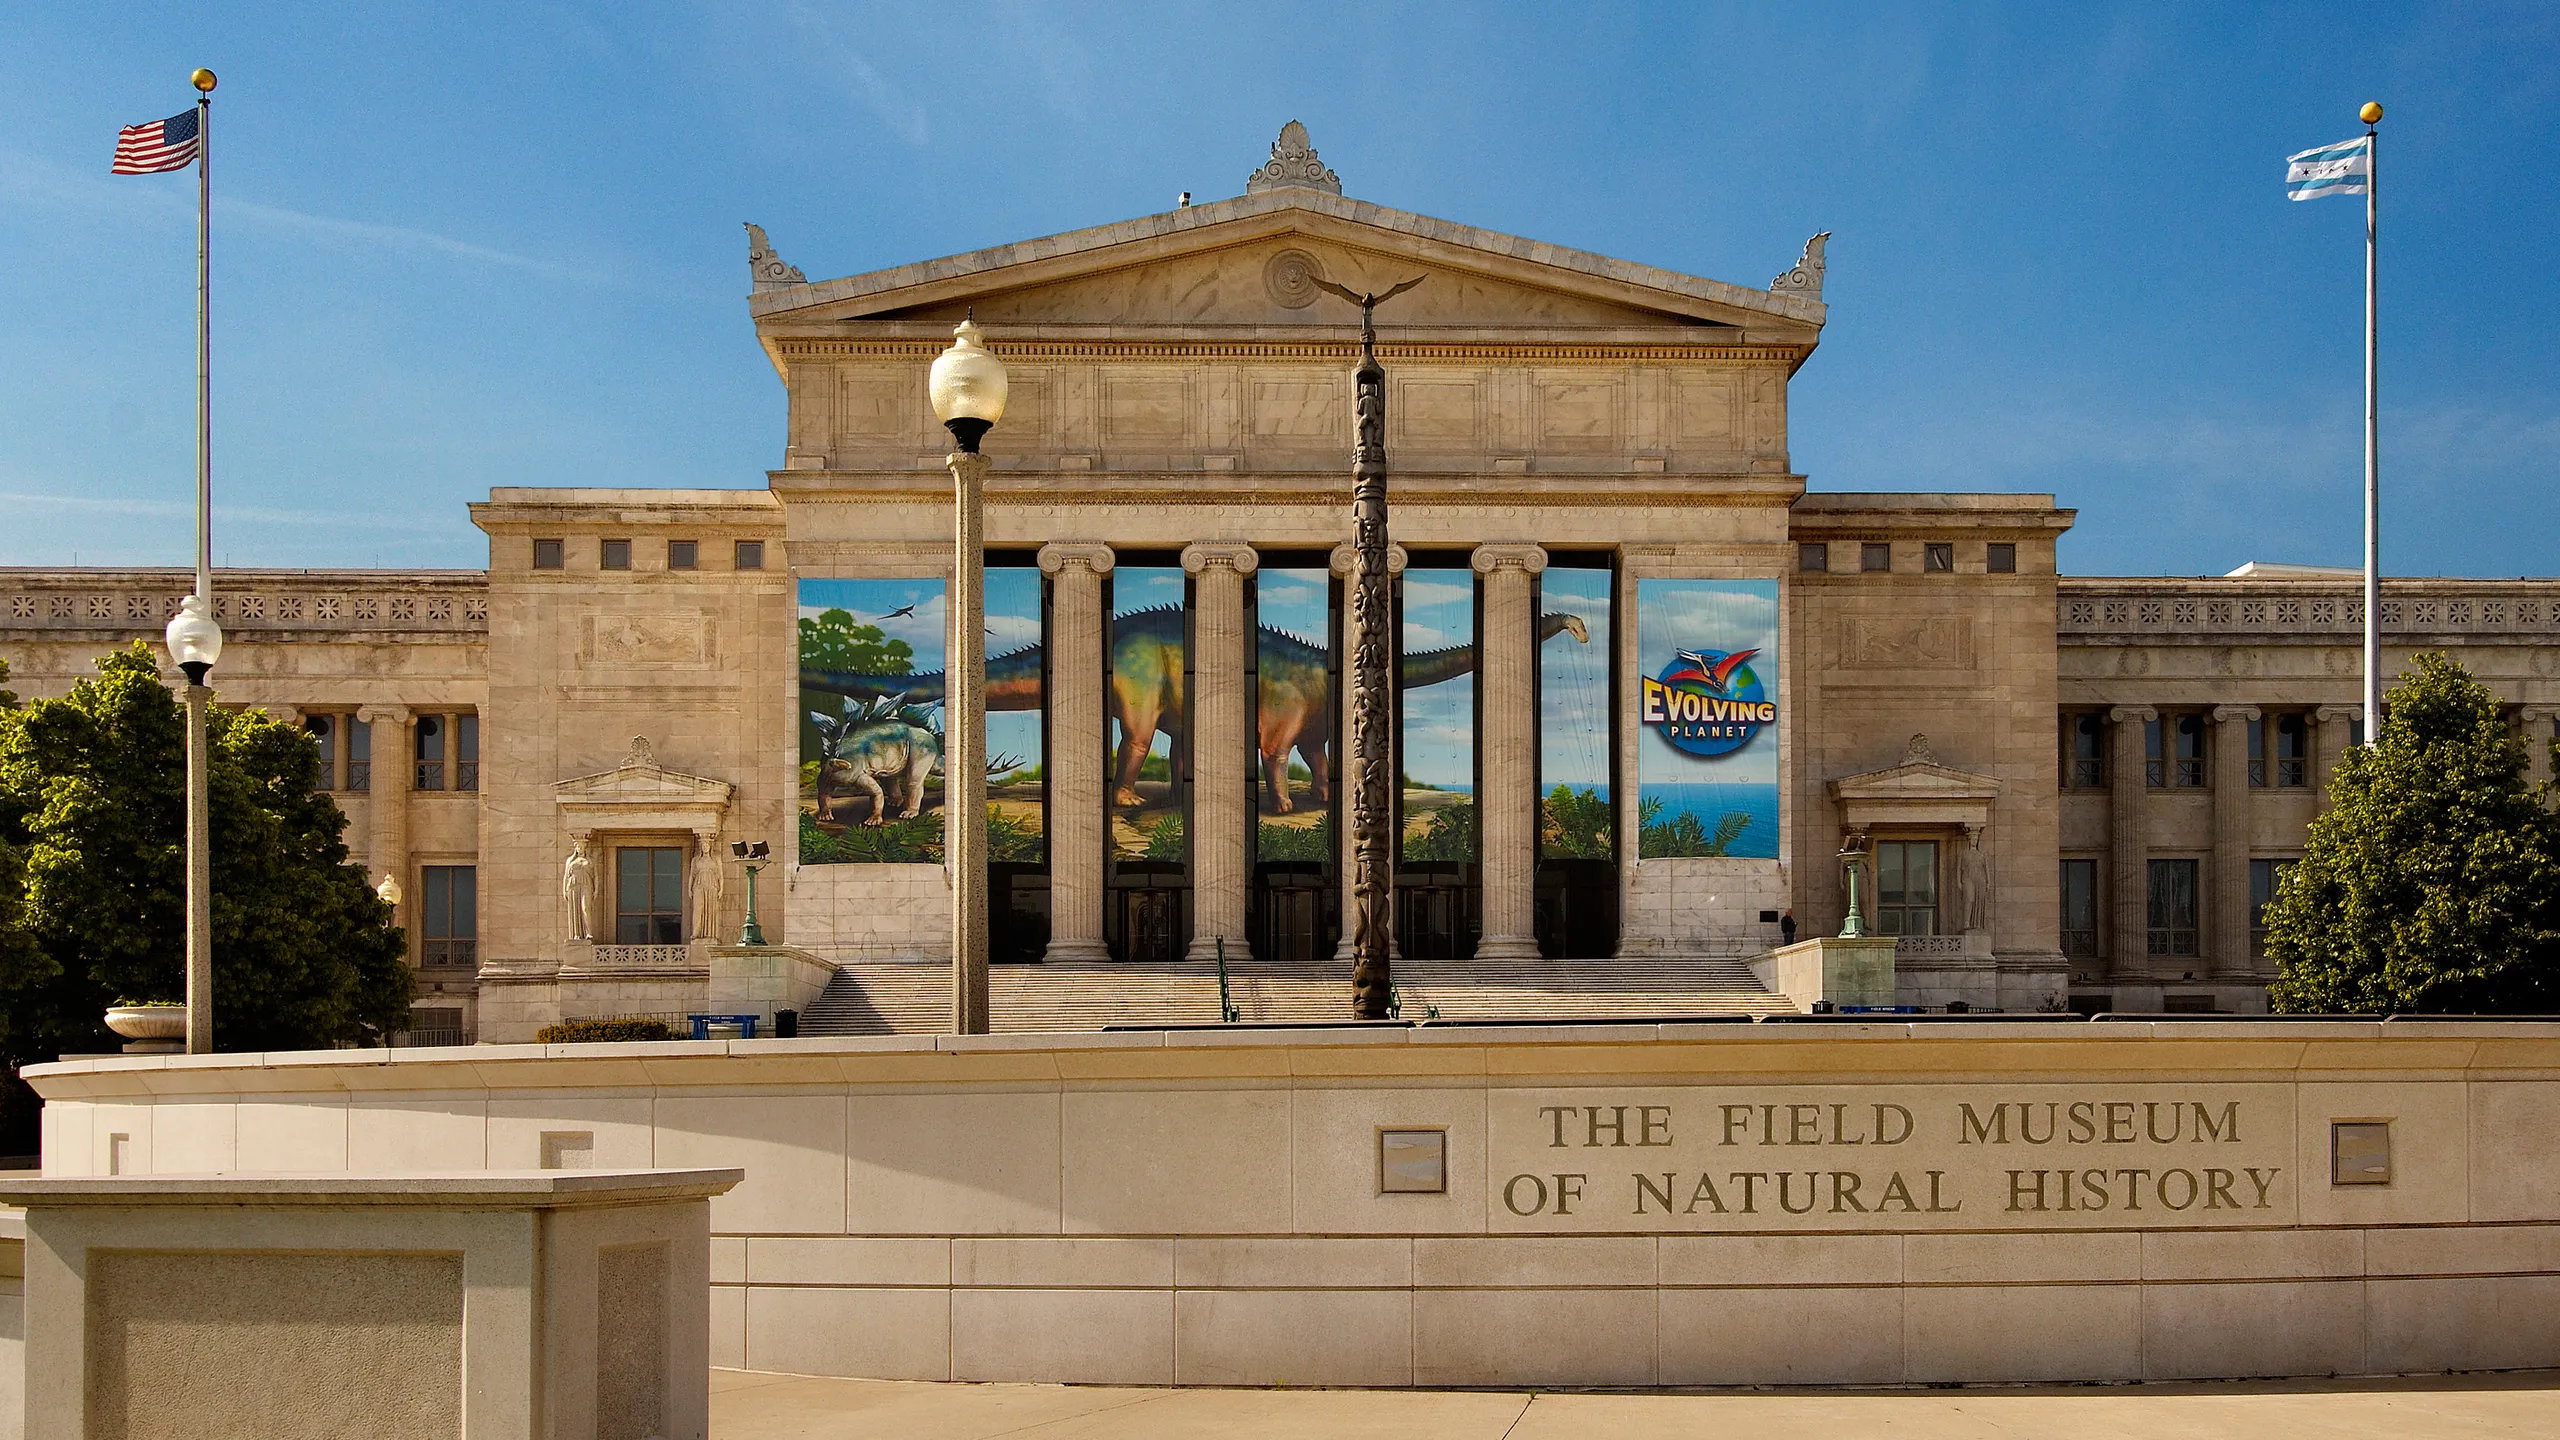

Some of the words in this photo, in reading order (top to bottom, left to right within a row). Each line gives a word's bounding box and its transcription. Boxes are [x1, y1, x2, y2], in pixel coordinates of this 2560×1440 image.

[1642, 676, 1775, 722] EVOLVING
[1671, 726, 1747, 737] PLANET
[1539, 1106, 1674, 1147] THE
[1718, 1104, 1914, 1146] FIELD
[1958, 1101, 2241, 1144] MUSEUM
[1503, 1173, 1588, 1217] OF
[1631, 1171, 1962, 1215] NATURAL
[2004, 1168, 2281, 1213] HISTORY
